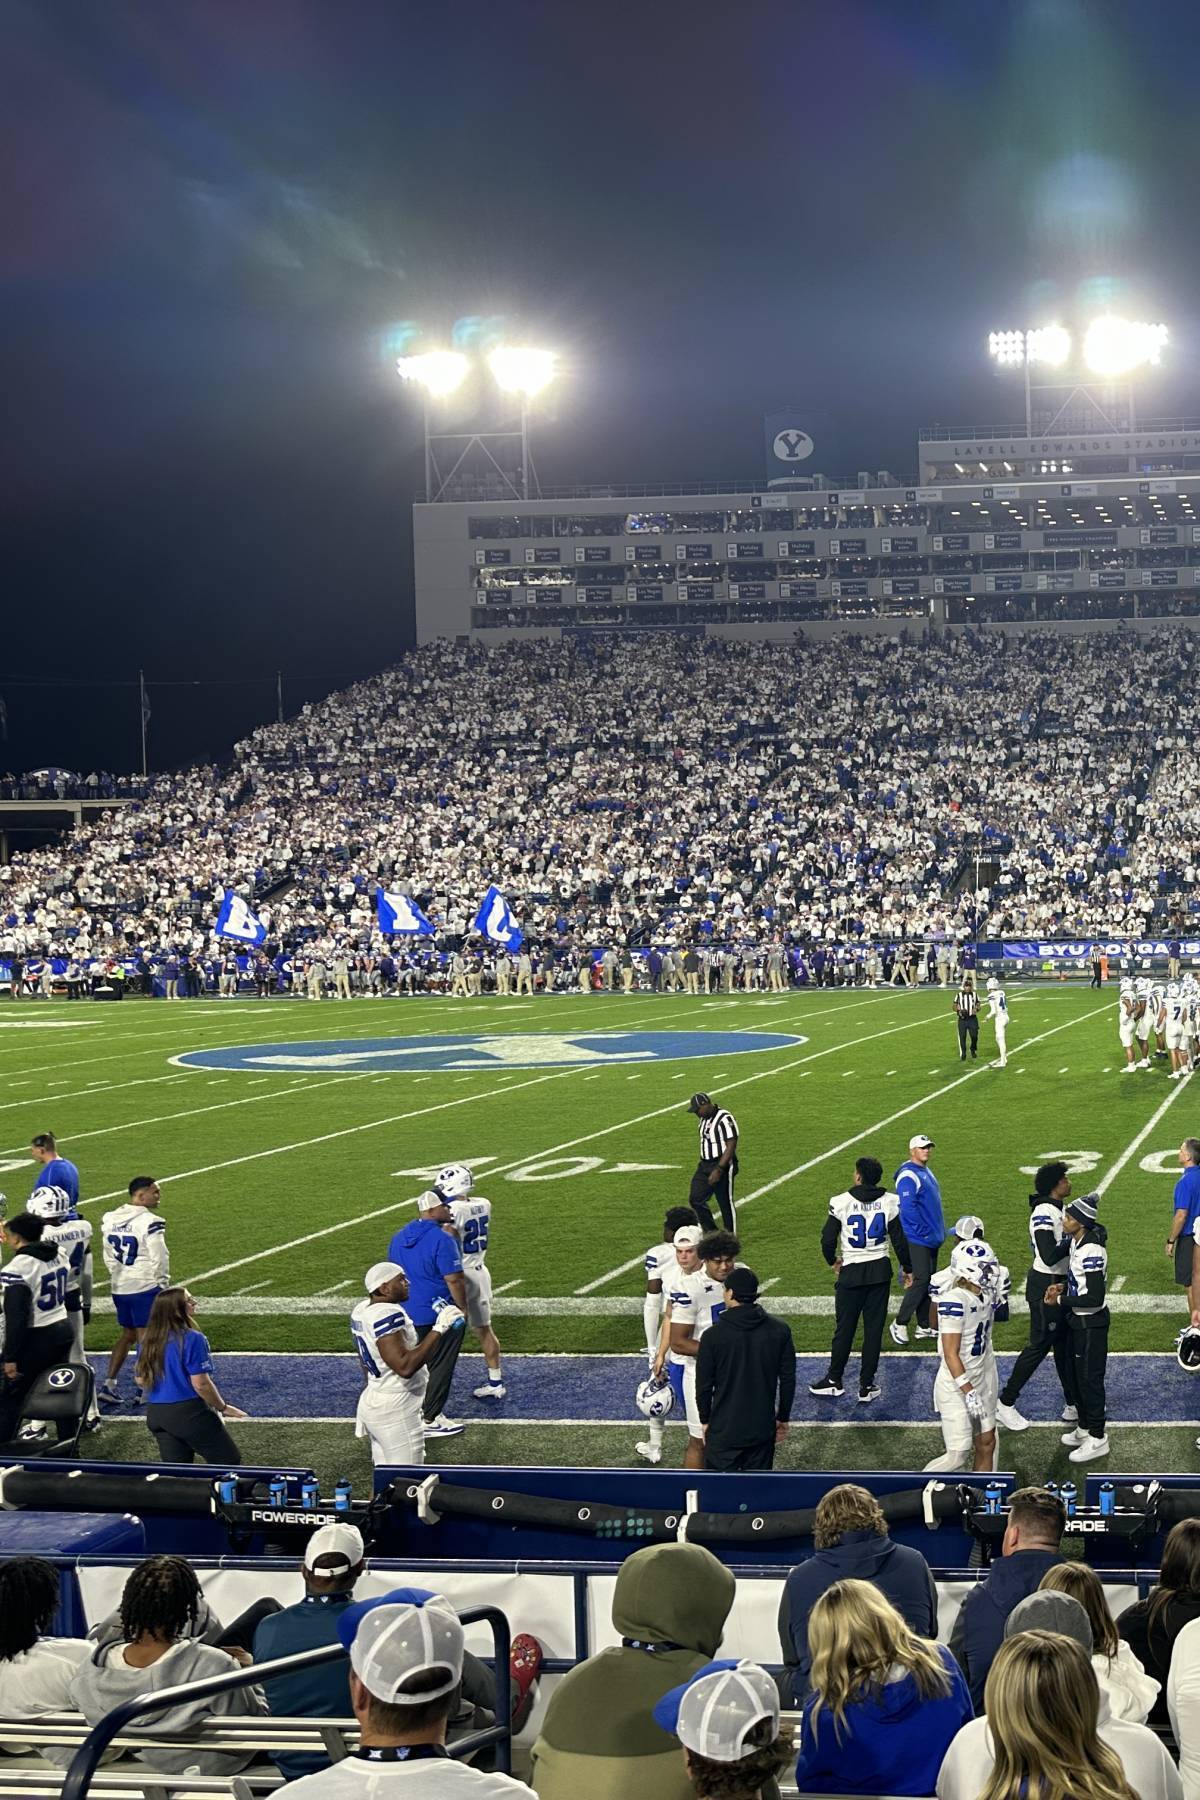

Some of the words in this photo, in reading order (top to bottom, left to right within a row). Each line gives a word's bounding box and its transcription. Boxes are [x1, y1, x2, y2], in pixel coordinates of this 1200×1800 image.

[954, 445, 1016, 456] LAVELL
[1031, 441, 1111, 453] EDWARDS
[1039, 943, 1080, 955] BYU
[463, 1214, 489, 1254] 25
[847, 1213, 887, 1249] 34
[107, 1235, 139, 1266] 37
[37, 1267, 68, 1311] 50
[252, 1510, 336, 1526] POWERADE
